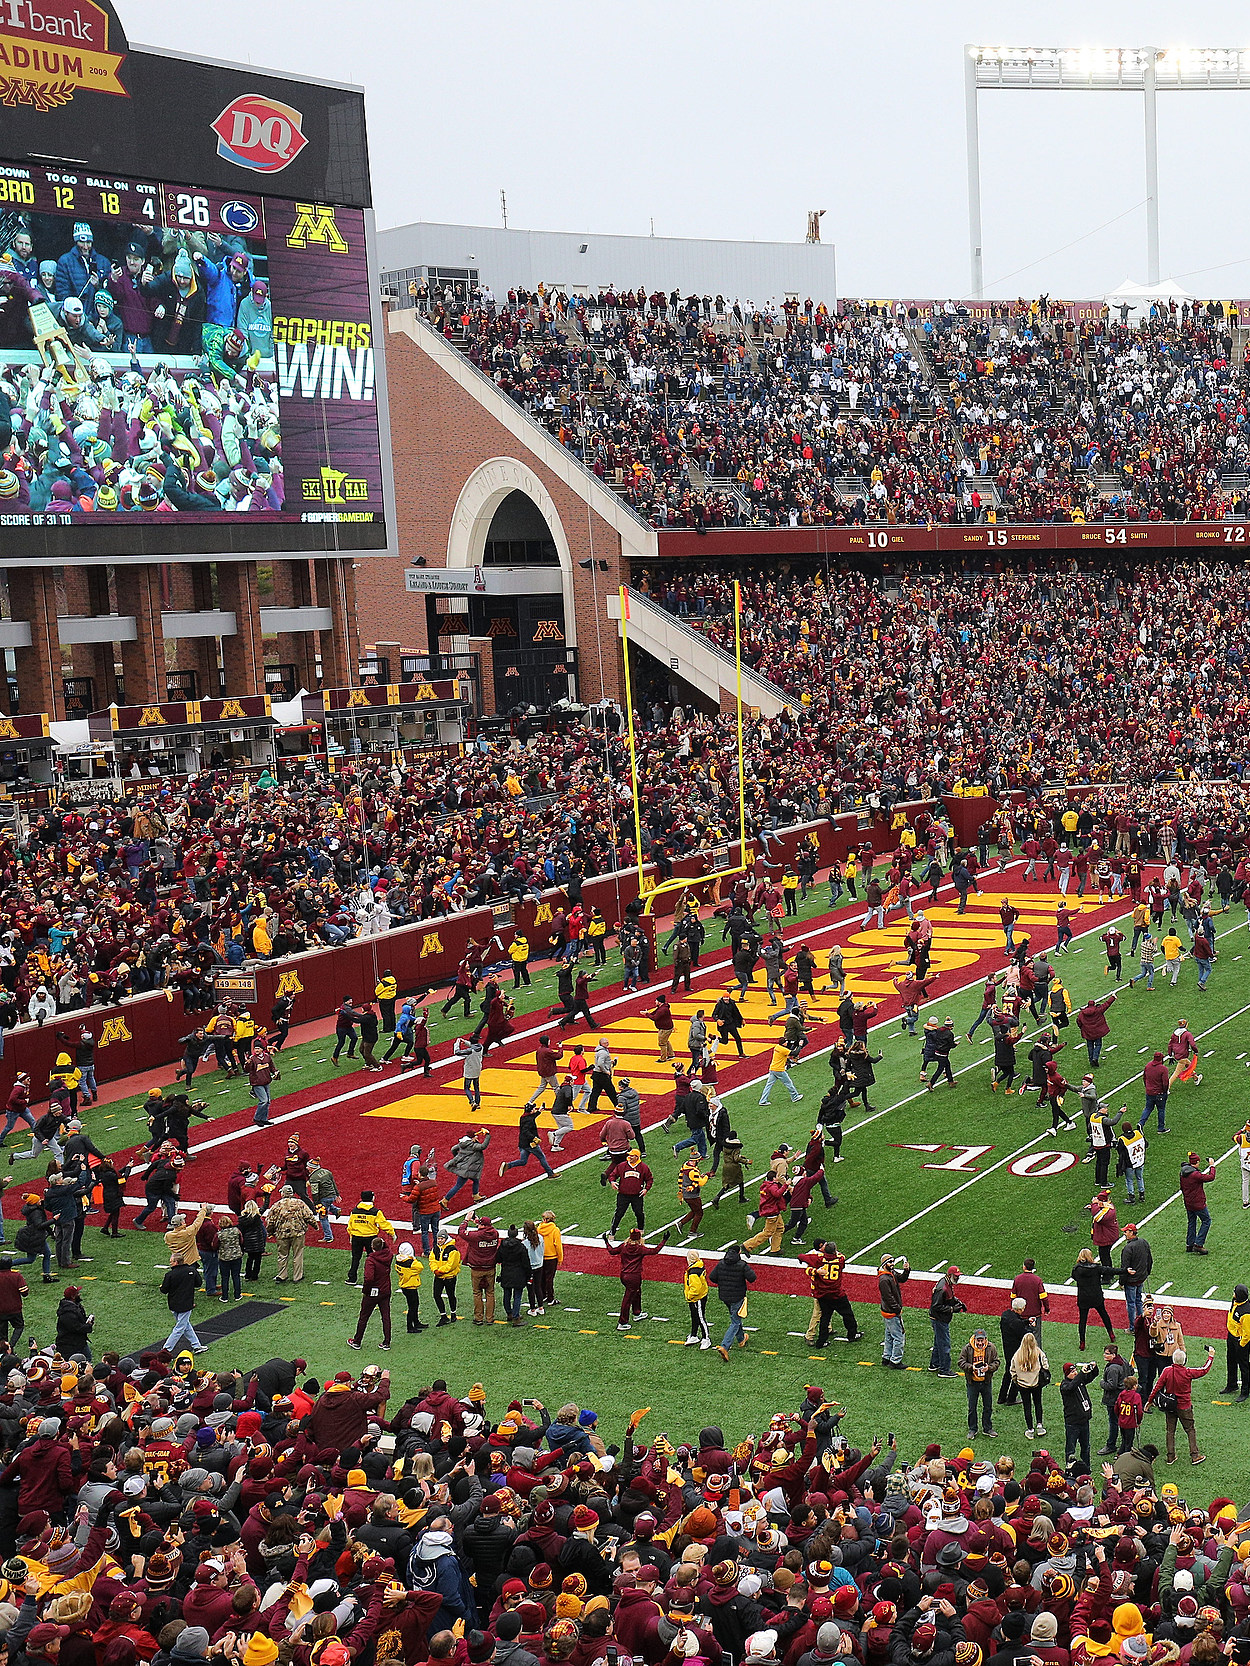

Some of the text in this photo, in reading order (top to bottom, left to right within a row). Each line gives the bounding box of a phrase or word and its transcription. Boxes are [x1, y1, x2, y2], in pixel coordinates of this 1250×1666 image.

[90, 66, 107, 76] 2009
[230, 110, 294, 159] DQ
[45, 172, 78, 185] TO GO
[86, 178, 129, 192] BALL ON
[136, 184, 157, 195] QTR
[53, 187, 75, 209] 12
[100, 192, 121, 215] 18
[142, 198, 155, 219] 4
[176, 193, 210, 227] 26
[273, 316, 371, 350] GOPHERS
[277, 343, 375, 400] WIN!
[302, 482, 321, 497] SKI
[345, 482, 367, 497] MAH
[1, 514, 71, 525] SCORE OF 31 TO
[867, 531, 888, 548] 10
[987, 530, 1008, 546] 15
[1104, 529, 1127, 544] 54
[1195, 531, 1220, 539] BRONKO
[1222, 527, 1245, 543] 72
[1130, 864, 1138, 874] 21
[922, 1142, 1081, 1180] 10
[75, 1405, 91, 1413] OLSON
[1120, 1403, 1131, 1416] 78
